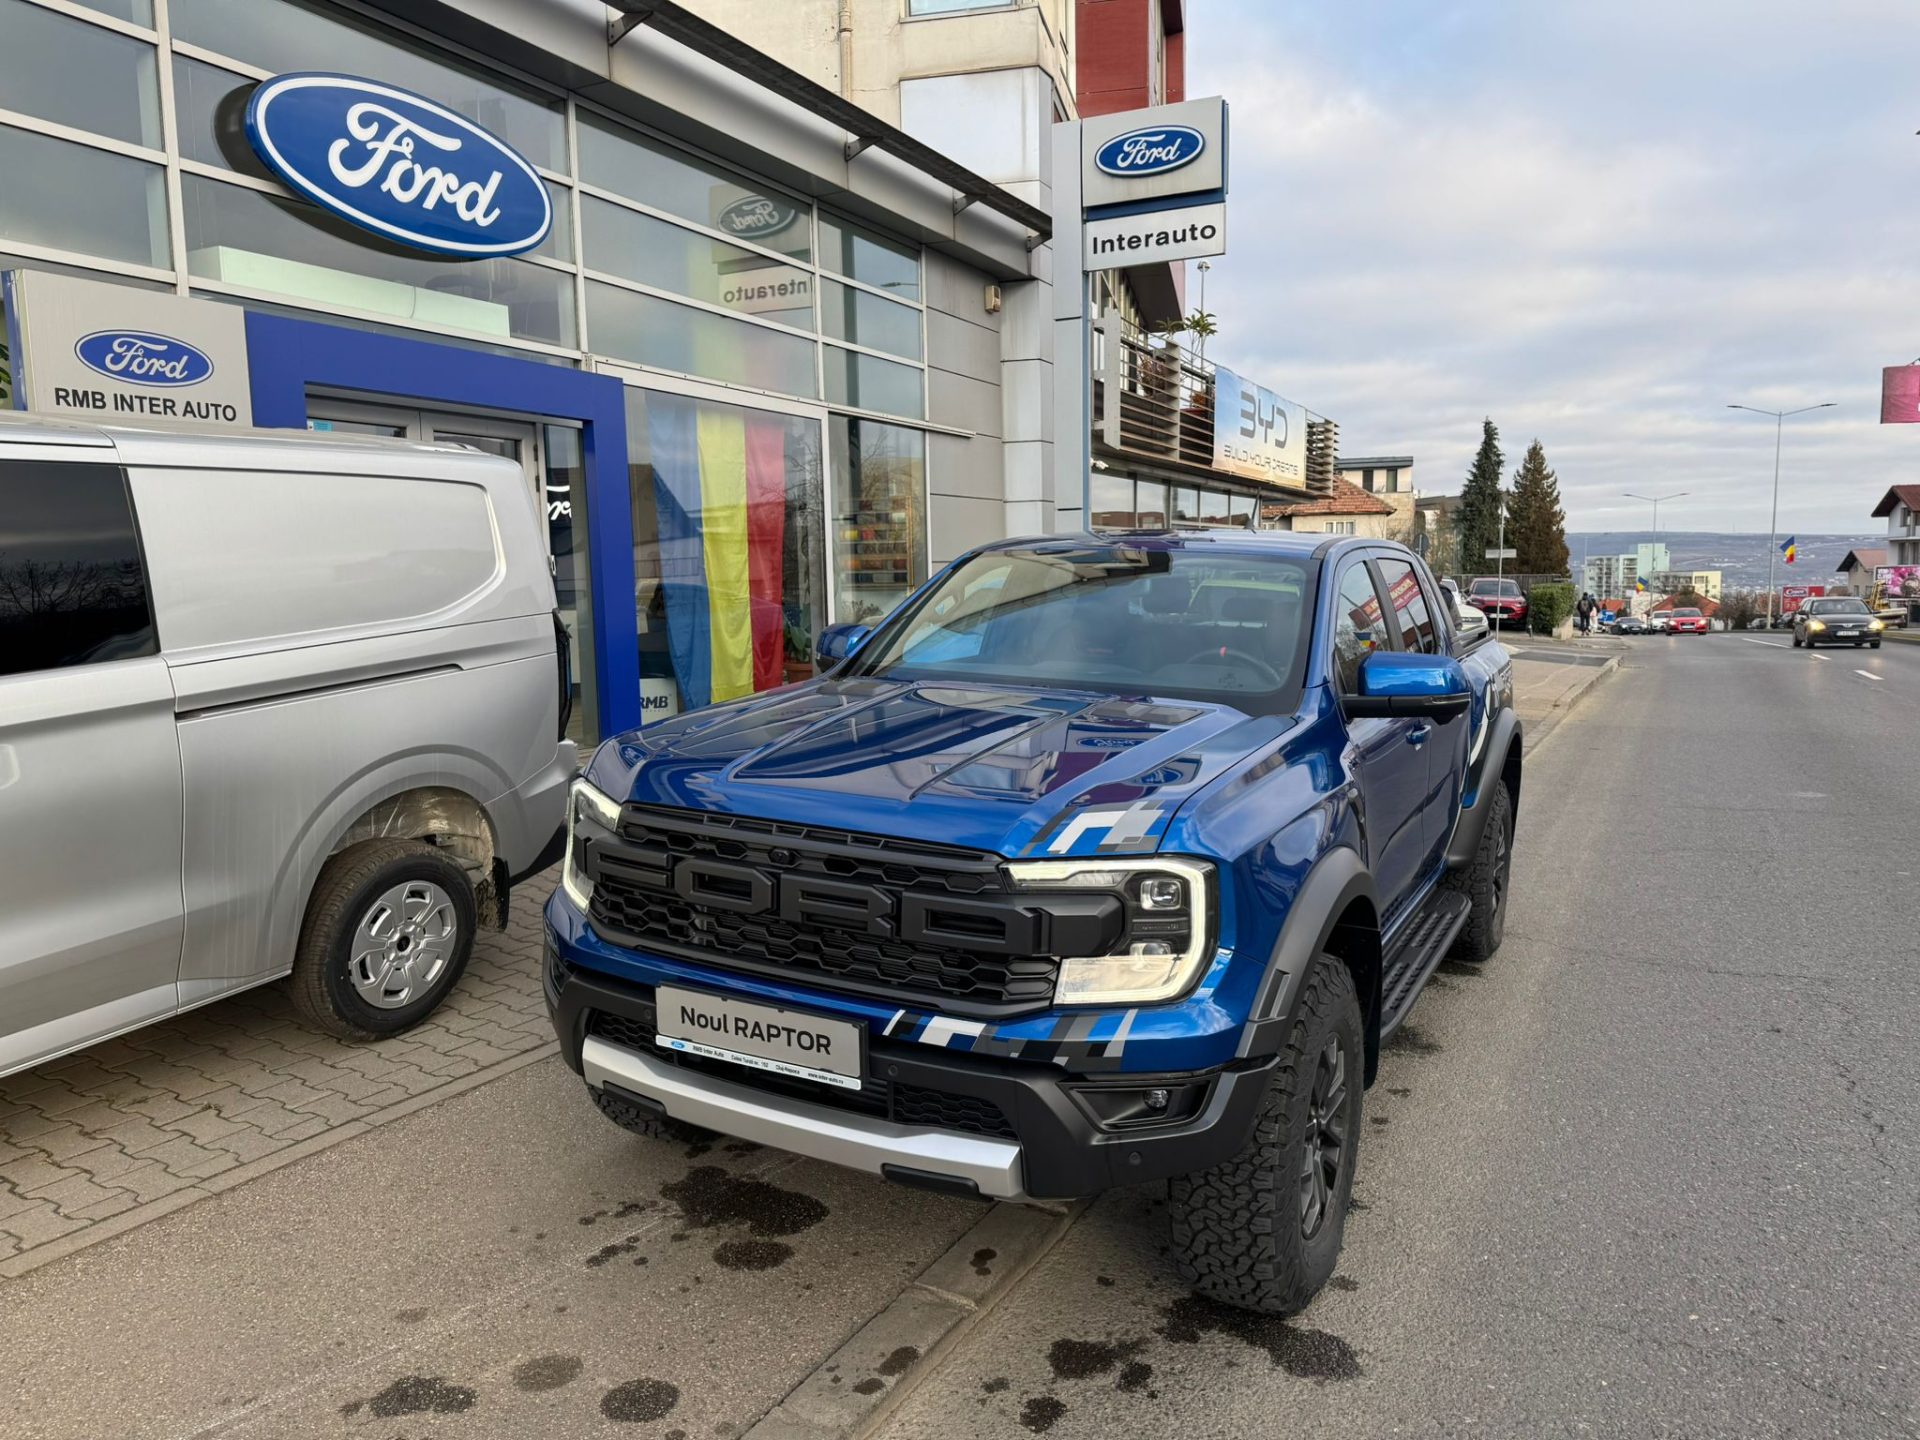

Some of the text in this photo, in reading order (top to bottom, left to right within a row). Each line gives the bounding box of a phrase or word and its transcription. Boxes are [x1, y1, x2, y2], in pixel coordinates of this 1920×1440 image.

[328, 102, 503, 227] Ford
[1116, 133, 1183, 168] Ford
[1093, 223, 1217, 254] Interauto
[105, 338, 189, 379] Ford
[55, 387, 237, 422] RMB INTER AUTO
[1240, 390, 1288, 449] BYD
[586, 836, 1039, 957] FORD
[681, 1006, 832, 1055] Noul RAPTOR
